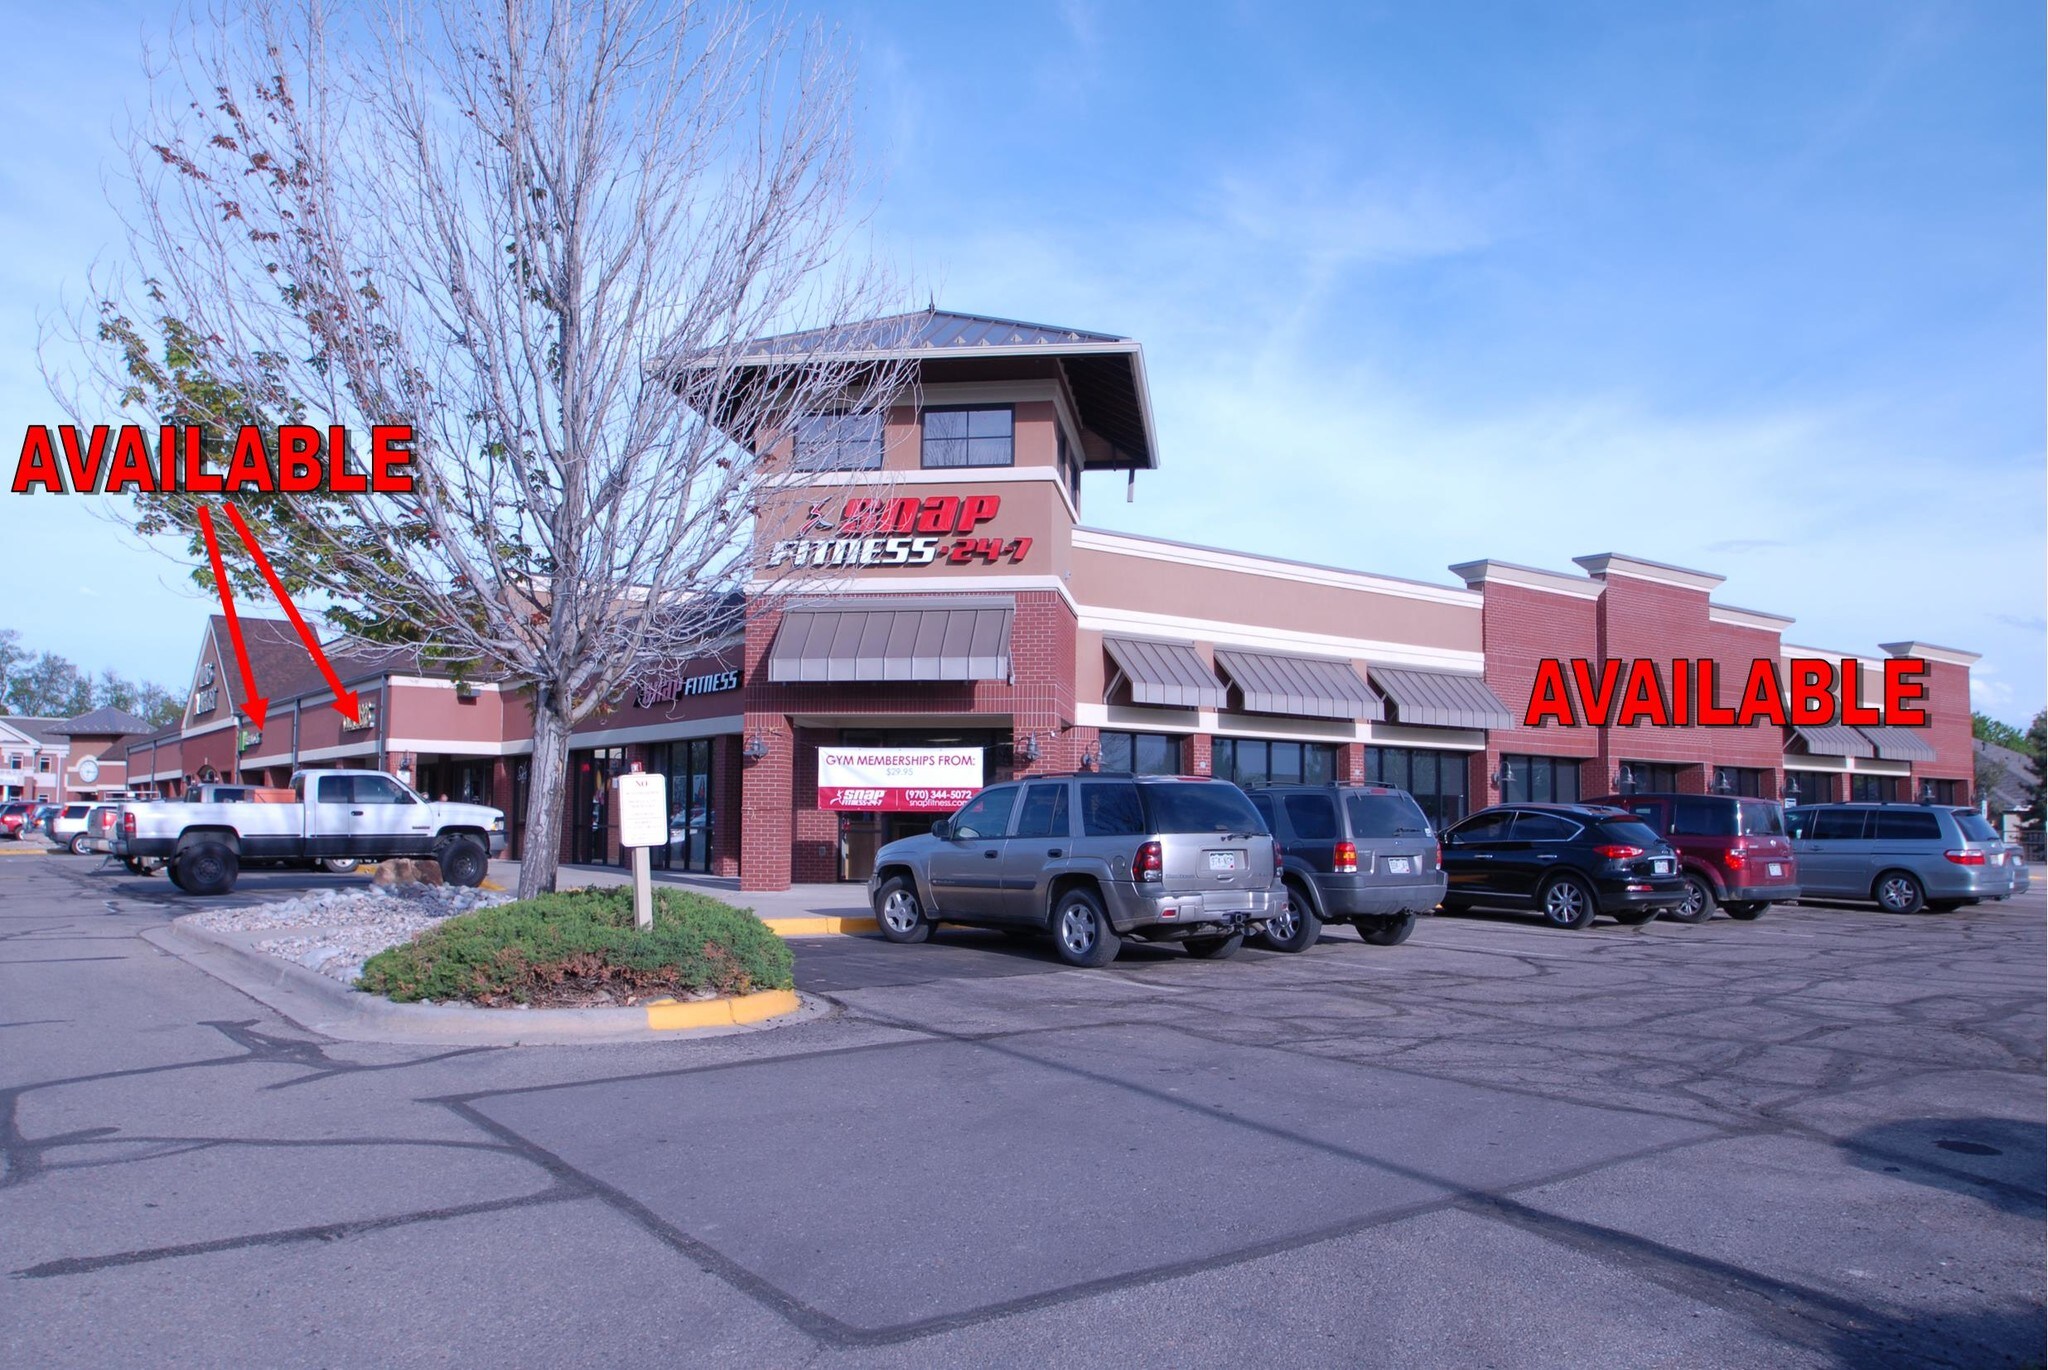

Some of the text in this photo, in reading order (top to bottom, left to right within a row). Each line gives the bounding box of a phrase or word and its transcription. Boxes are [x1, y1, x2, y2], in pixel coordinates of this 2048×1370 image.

[684, 670, 738, 696] FITNESS
[825, 754, 976, 766] GYM MEMBERSHIPS FROM:
[886, 767, 914, 776] $29.95
[905, 789, 929, 801] (970)
[930, 789, 972, 799] 344-5072
